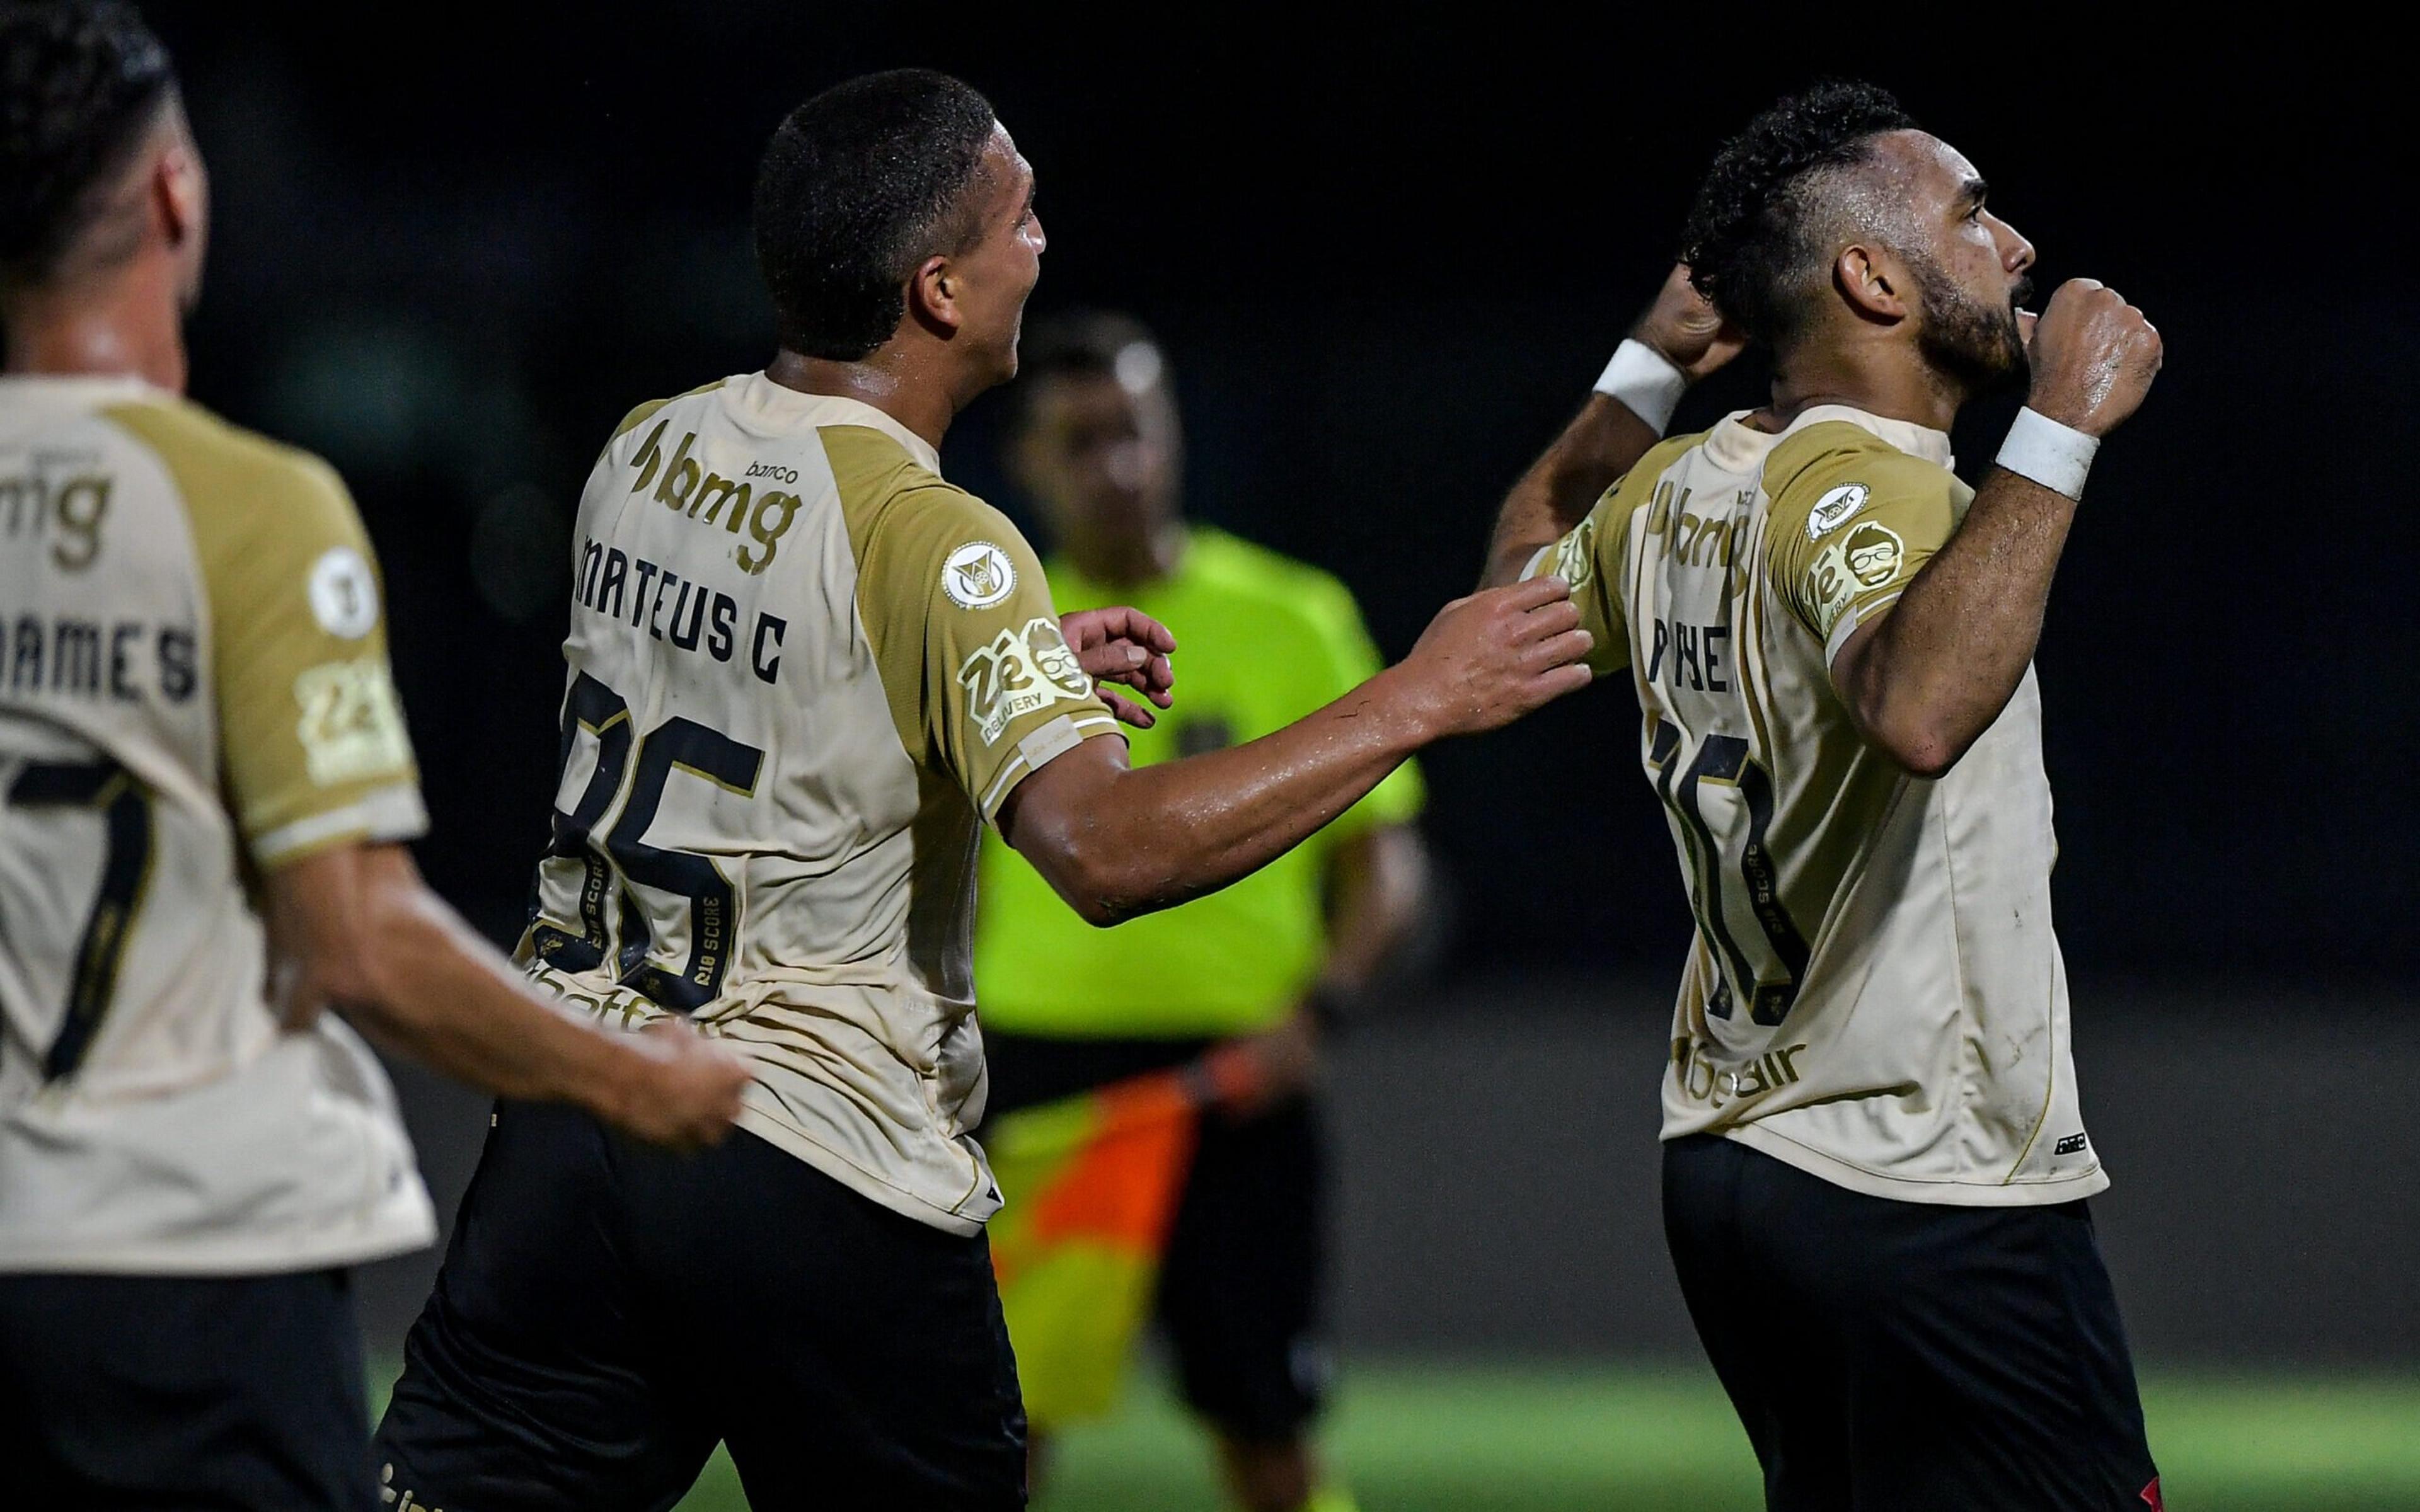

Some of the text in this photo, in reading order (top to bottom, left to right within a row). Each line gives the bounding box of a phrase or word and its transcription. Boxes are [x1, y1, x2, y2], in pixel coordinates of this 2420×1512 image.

[654, 432, 802, 576] bmg
[746, 461, 798, 484] banco
[575, 535, 787, 685] MATEUS C
[0, 612, 199, 703] AMES
[984, 692, 1041, 741] DELIVERY
[703, 896, 721, 951] SCORE
